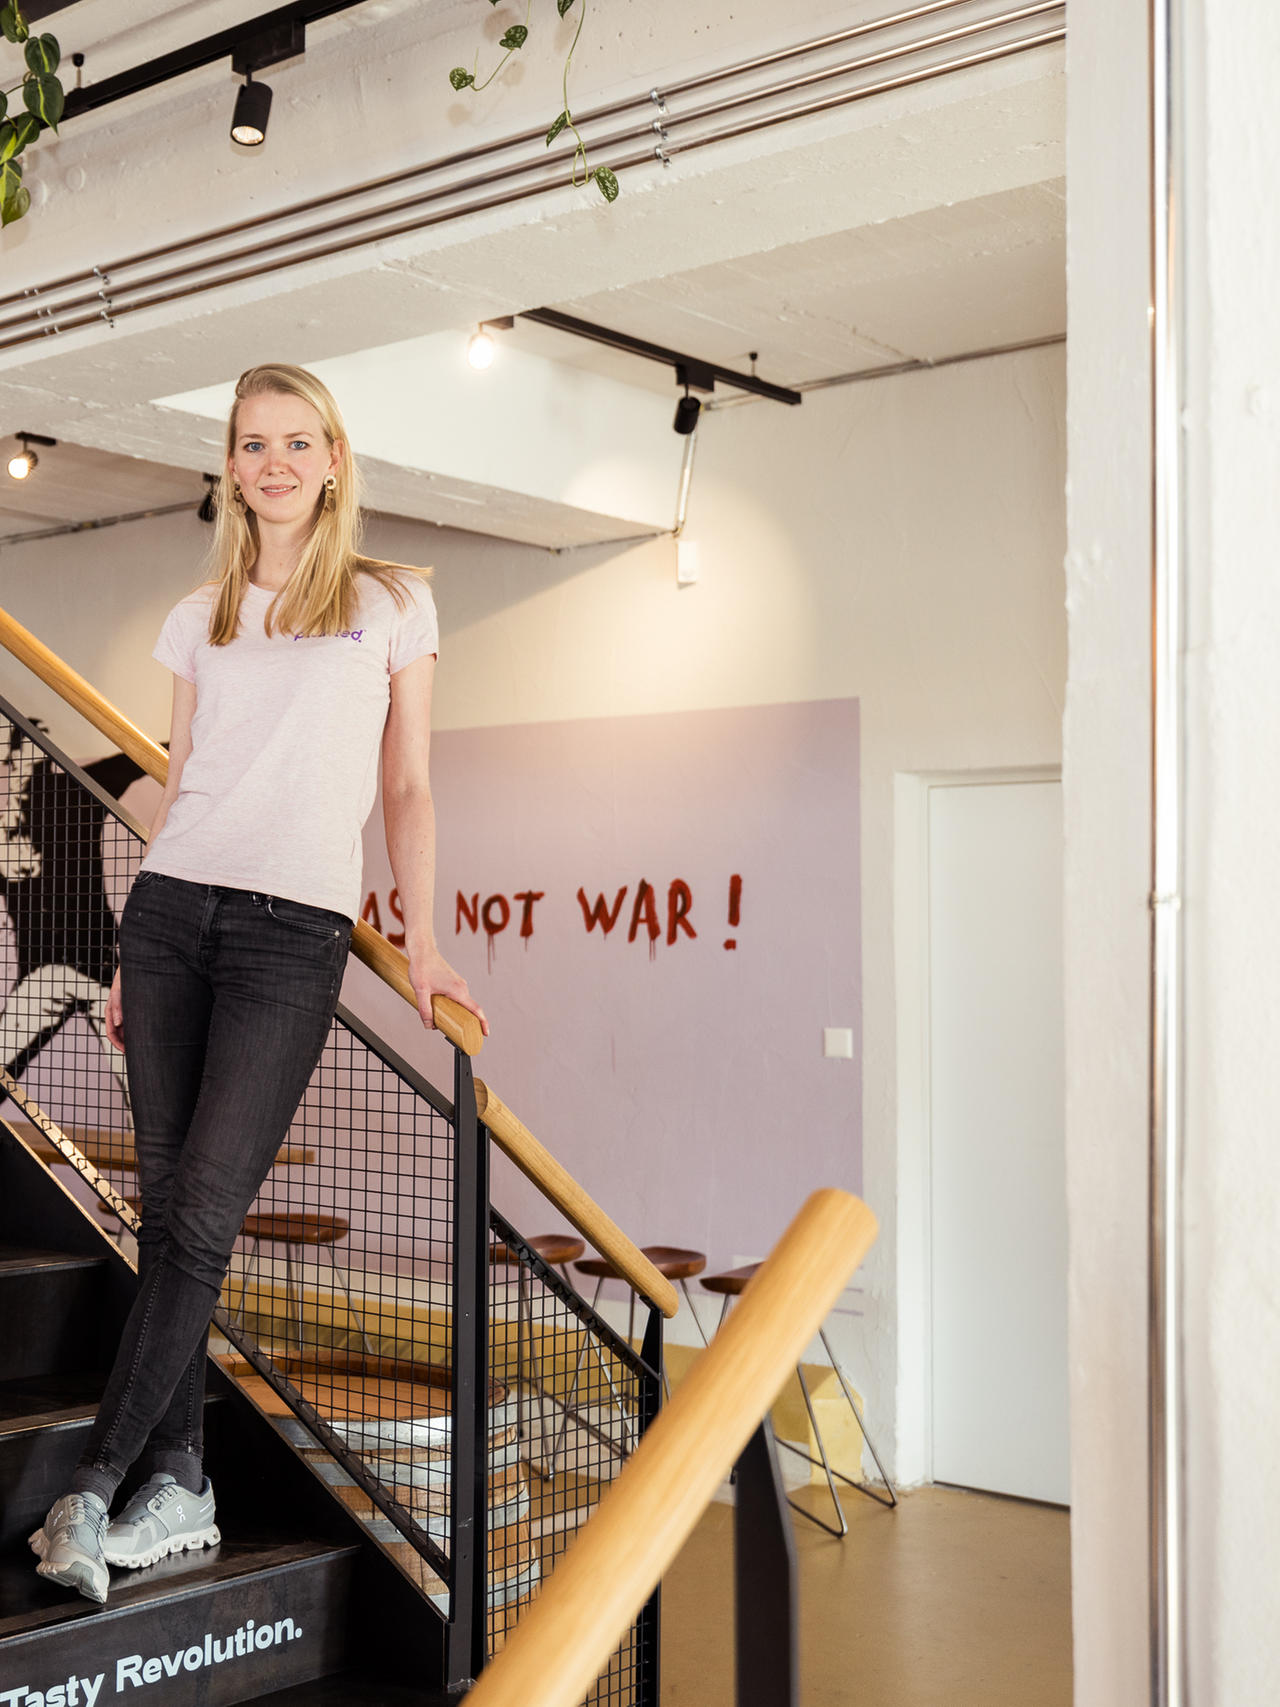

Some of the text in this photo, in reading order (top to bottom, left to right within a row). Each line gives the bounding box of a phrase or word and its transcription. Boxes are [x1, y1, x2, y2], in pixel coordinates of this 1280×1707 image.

[456, 889, 546, 945] NOT
[0, 1617, 304, 1707] Tasty Revolution.
